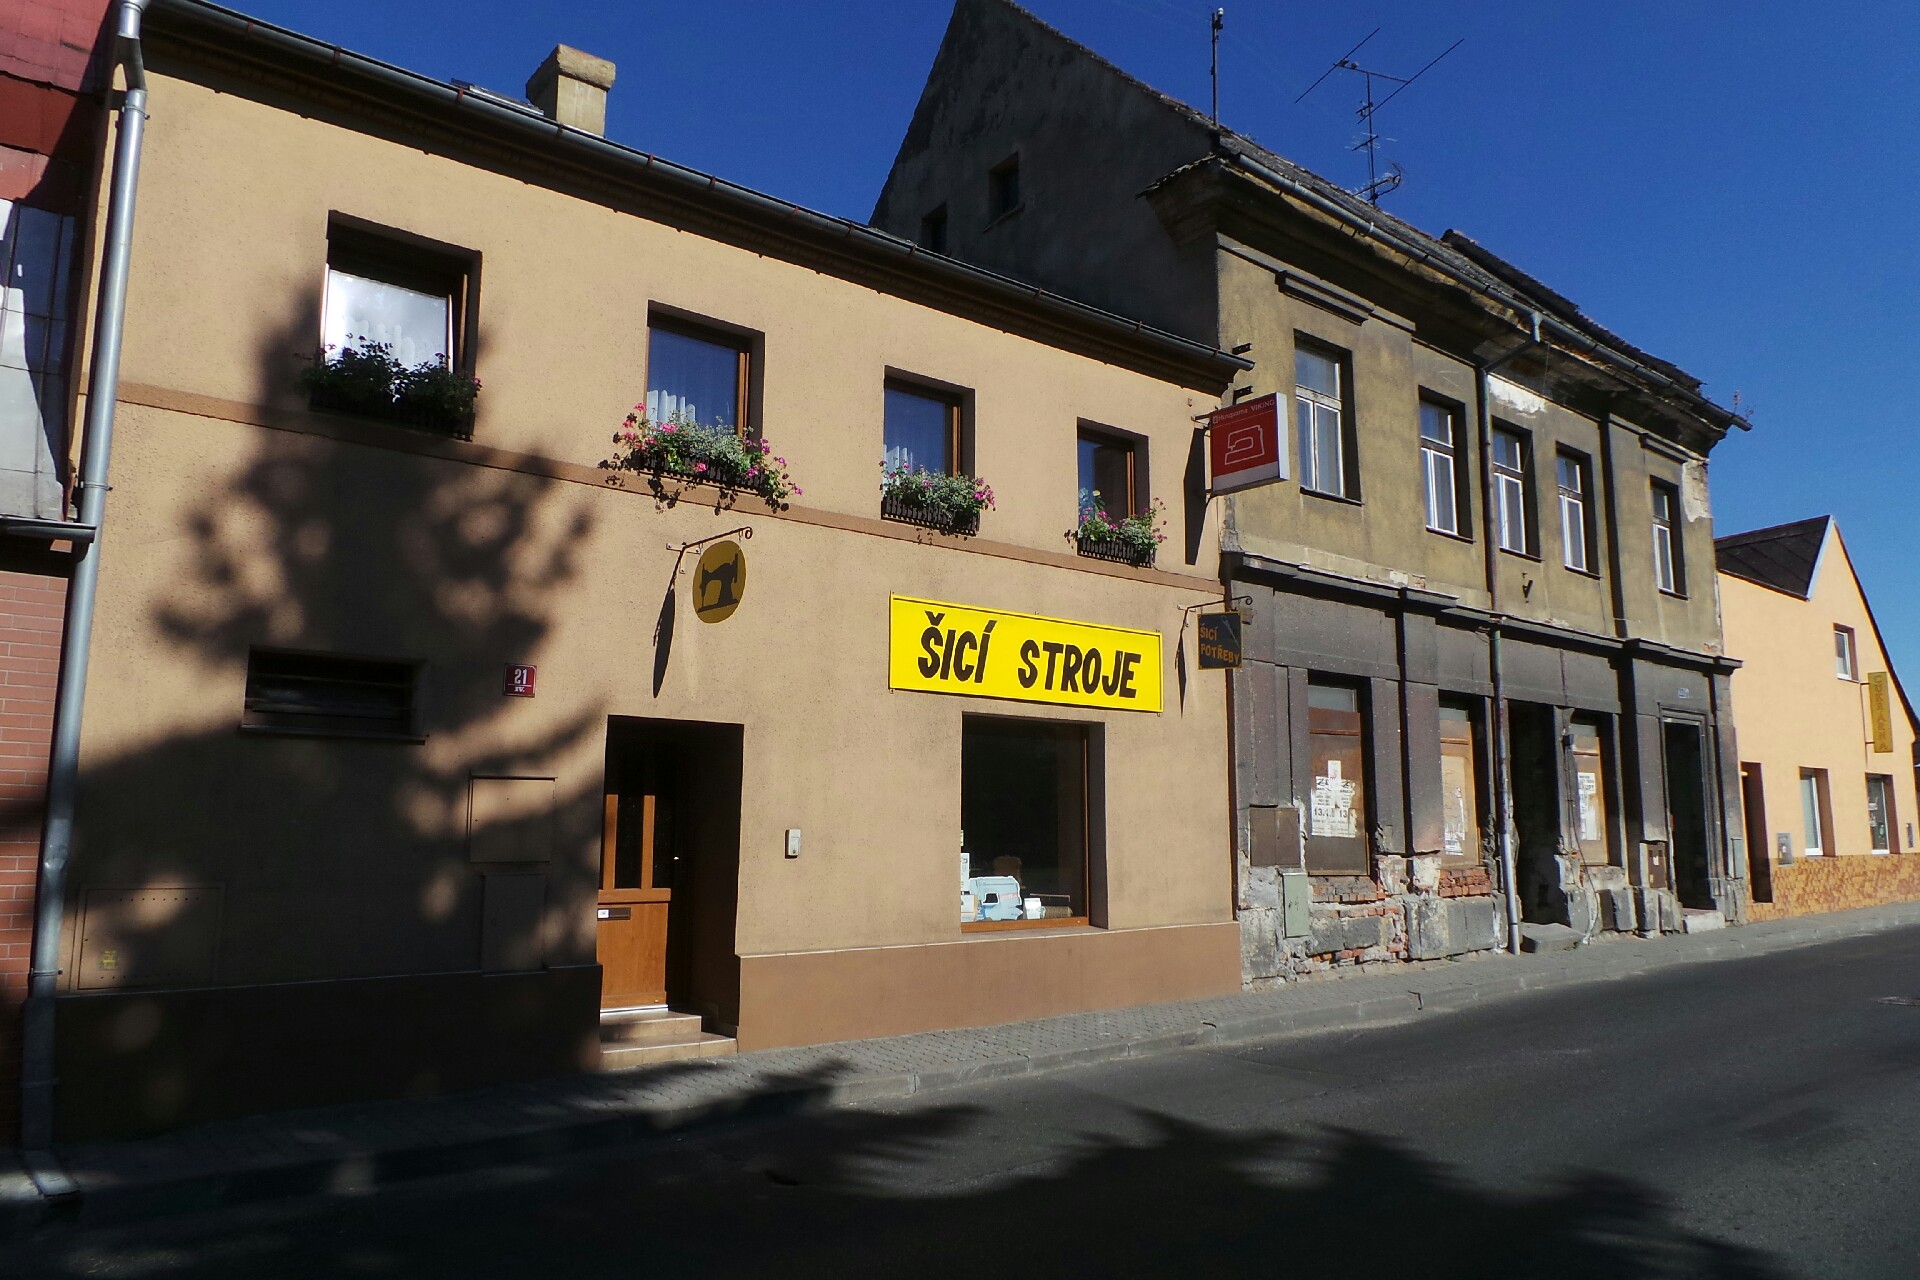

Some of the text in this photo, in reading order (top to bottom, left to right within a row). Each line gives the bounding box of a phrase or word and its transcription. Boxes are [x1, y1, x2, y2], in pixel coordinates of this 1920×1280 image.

[1251, 400, 1275, 410] VIKING
[1200, 623, 1218, 640] ŠICÍ
[918, 610, 1142, 699] ŠICÍ STROJE
[1200, 644, 1240, 665] POTŘEBY
[514, 668, 528, 684] 21
